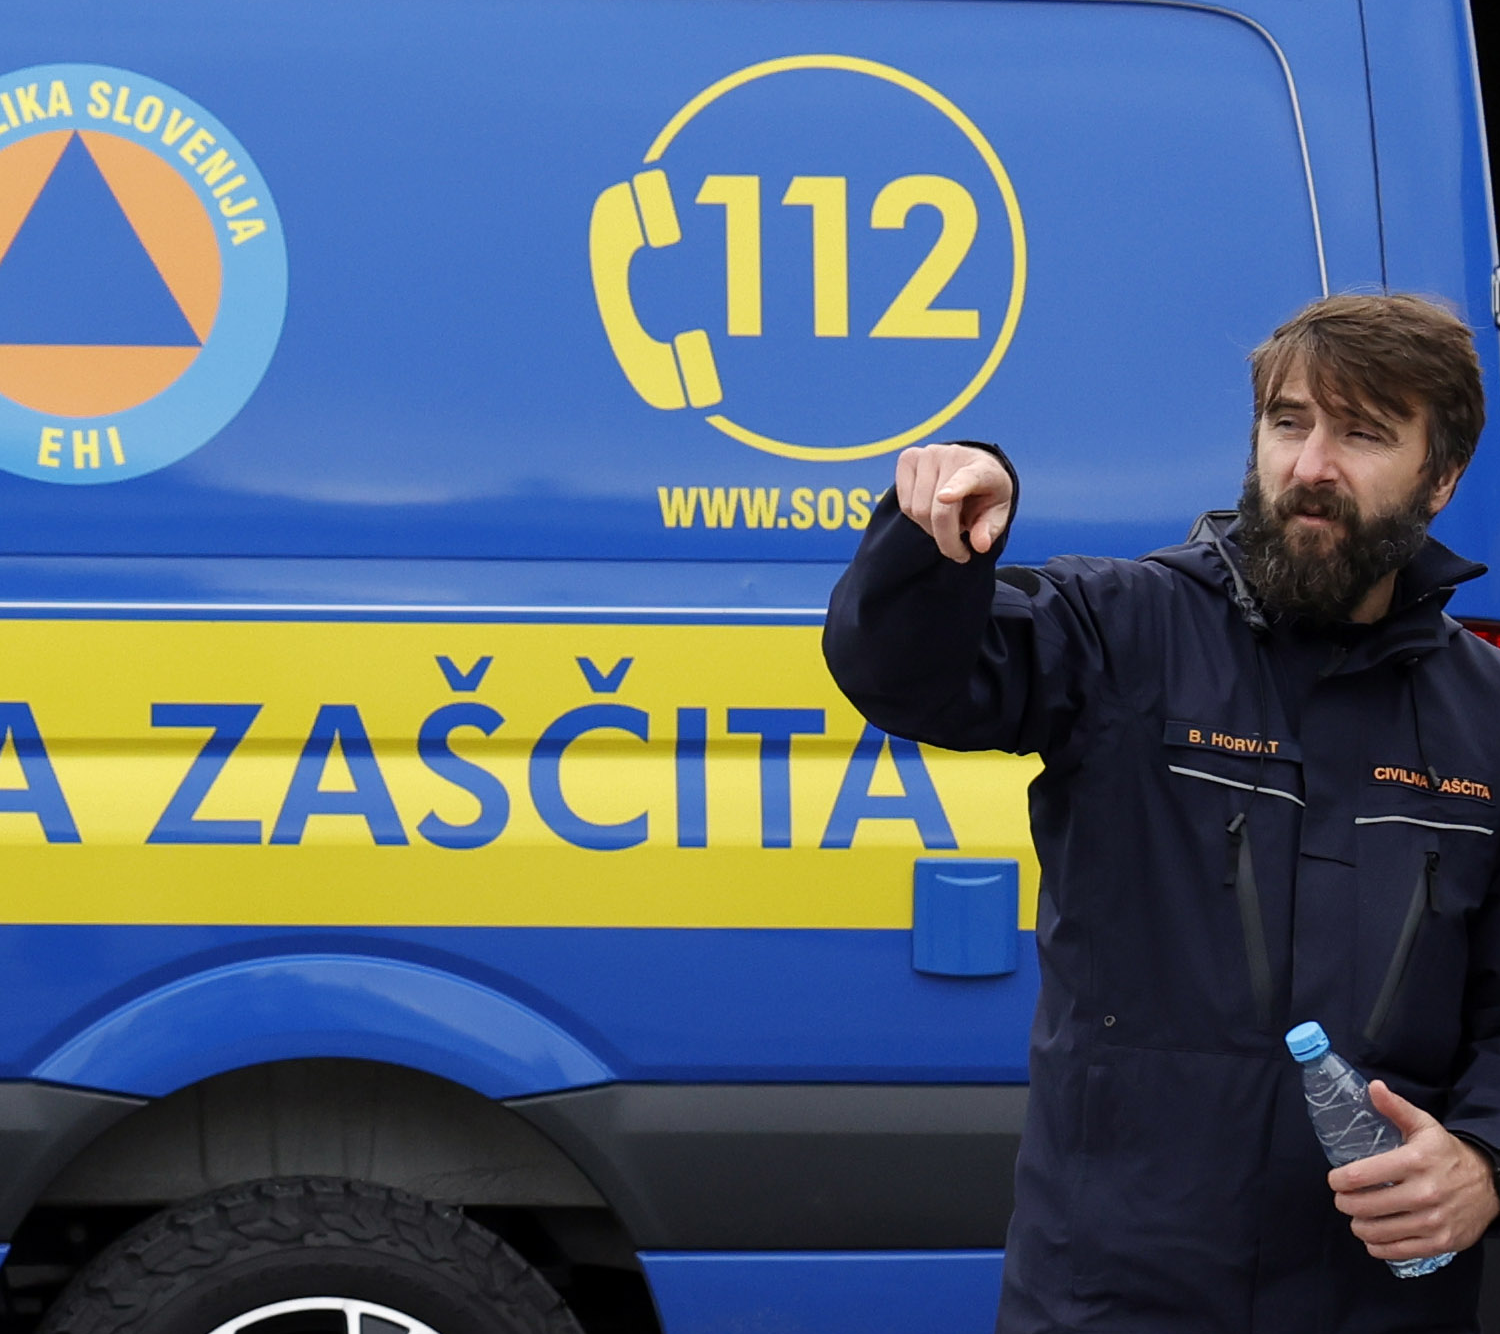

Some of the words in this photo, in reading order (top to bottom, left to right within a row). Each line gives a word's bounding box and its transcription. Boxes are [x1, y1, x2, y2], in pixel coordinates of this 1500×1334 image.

[86, 80, 268, 247] SLOVENIJA
[696, 173, 981, 340] 112
[36, 425, 127, 470] EHI
[657, 486, 889, 531] WWW.SOS
[145, 654, 960, 853] ZAŠČITA
[1188, 728, 1206, 745] B.
[1374, 766, 1430, 789] CIVILNA
[1432, 775, 1491, 801] AŠČITA
